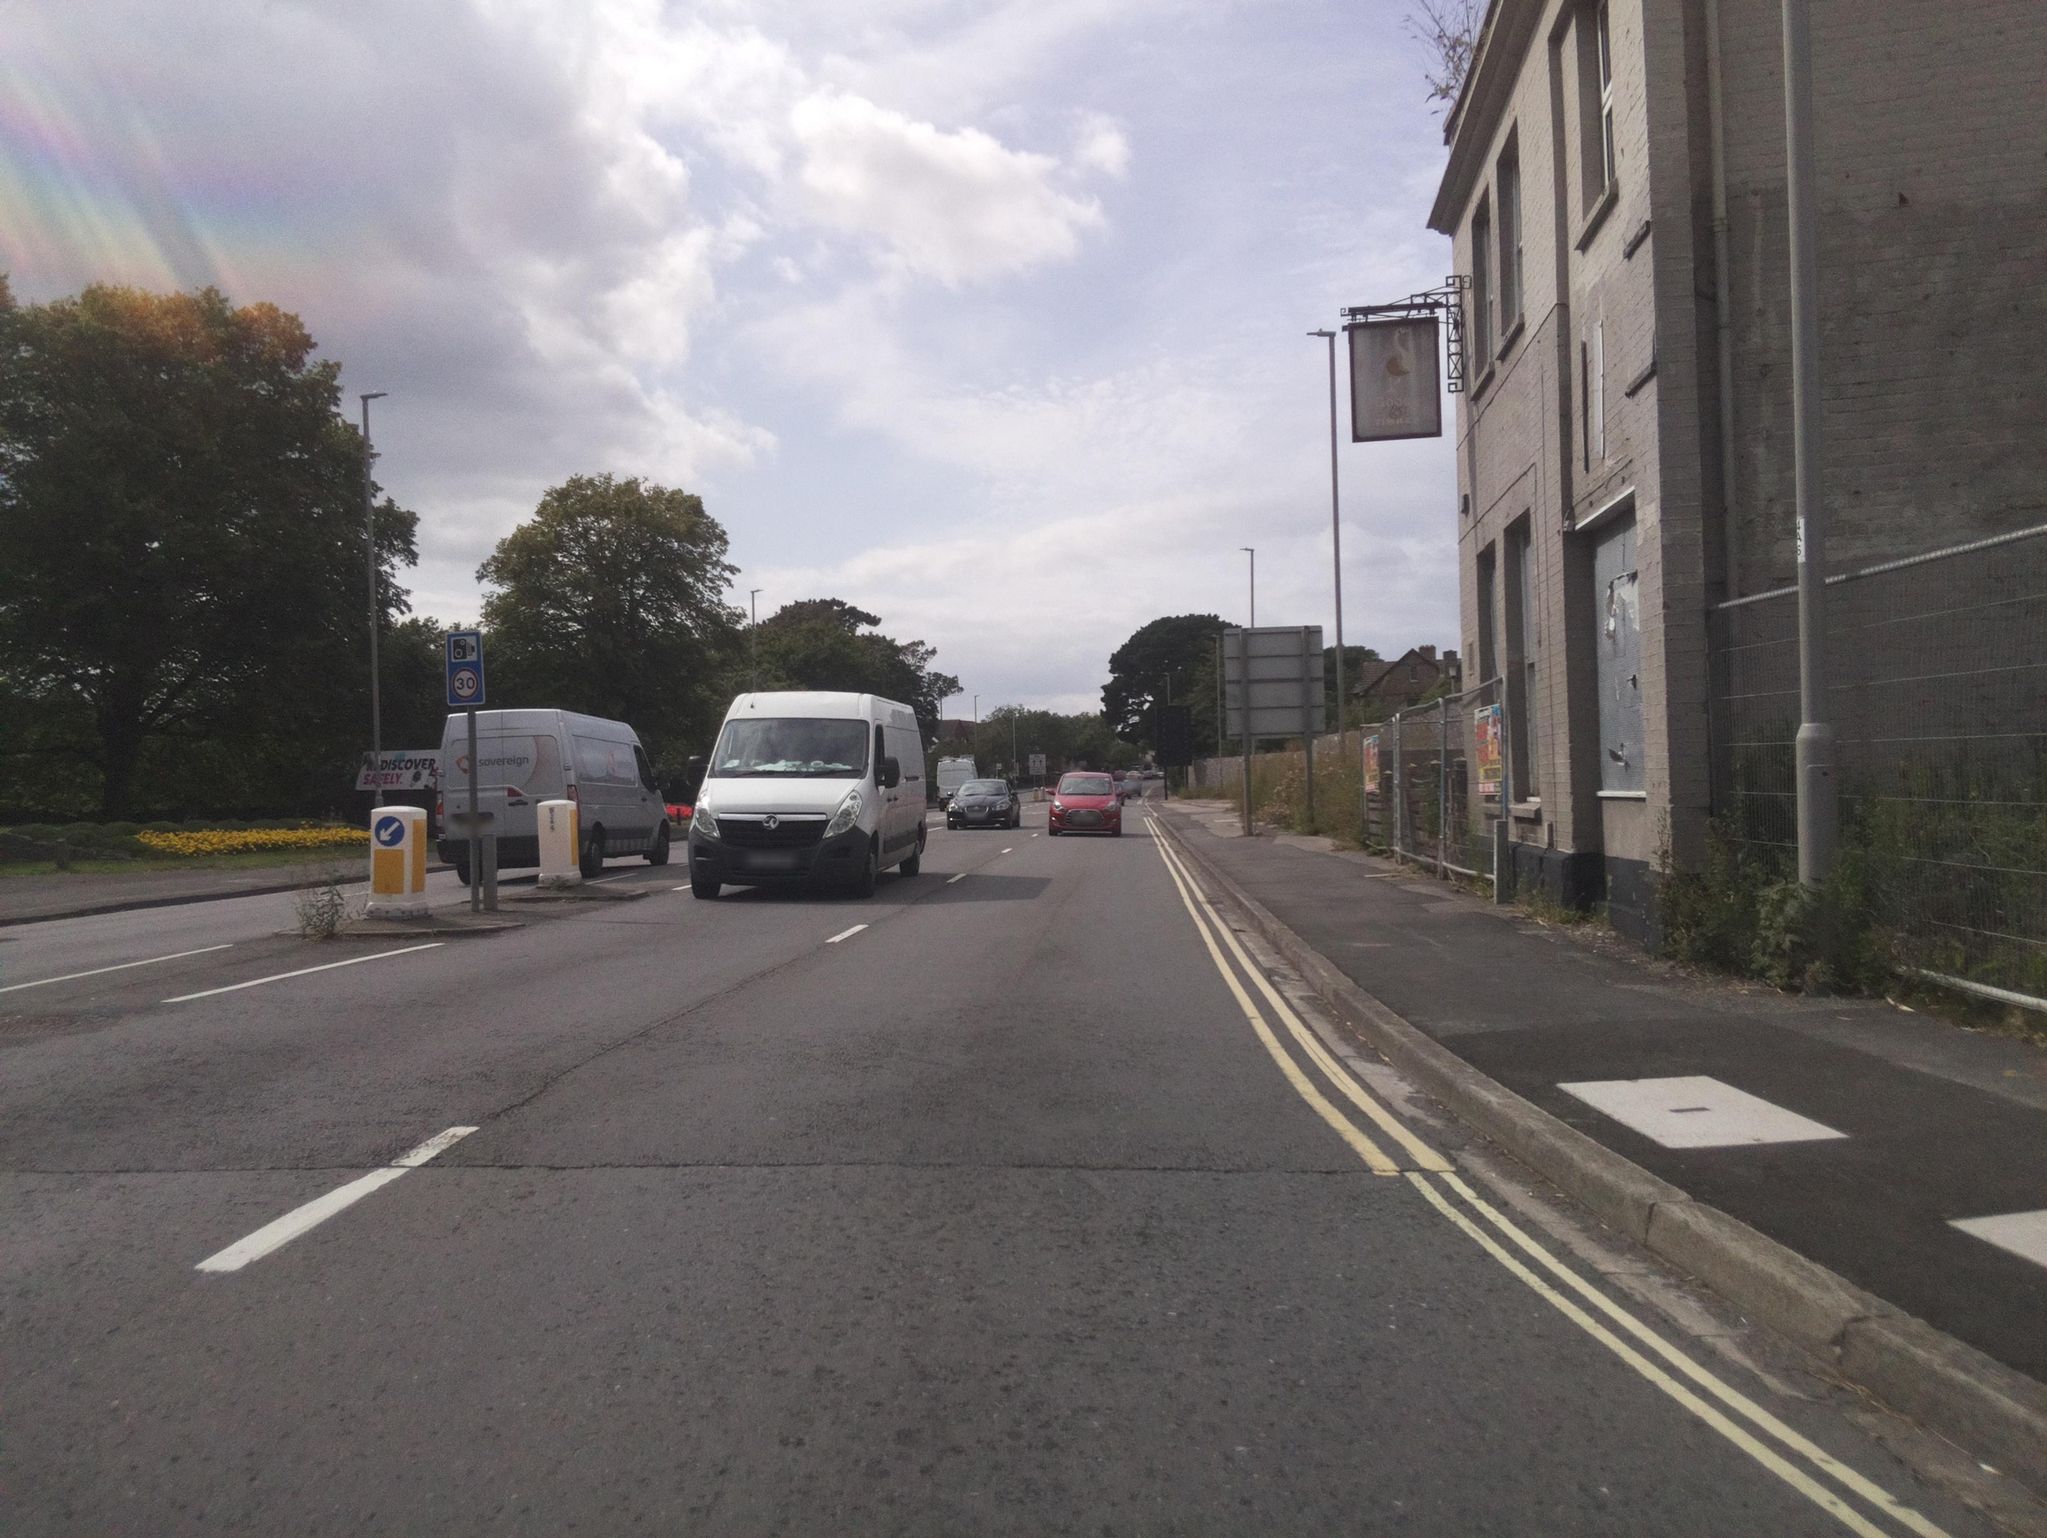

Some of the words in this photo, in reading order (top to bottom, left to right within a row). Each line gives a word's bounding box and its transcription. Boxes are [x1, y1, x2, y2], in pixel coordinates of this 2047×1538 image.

[456, 677, 475, 690] 30
[366, 758, 436, 772] DISCOVER
[478, 755, 529, 768] sovereign
[363, 773, 403, 786] SAELY.
